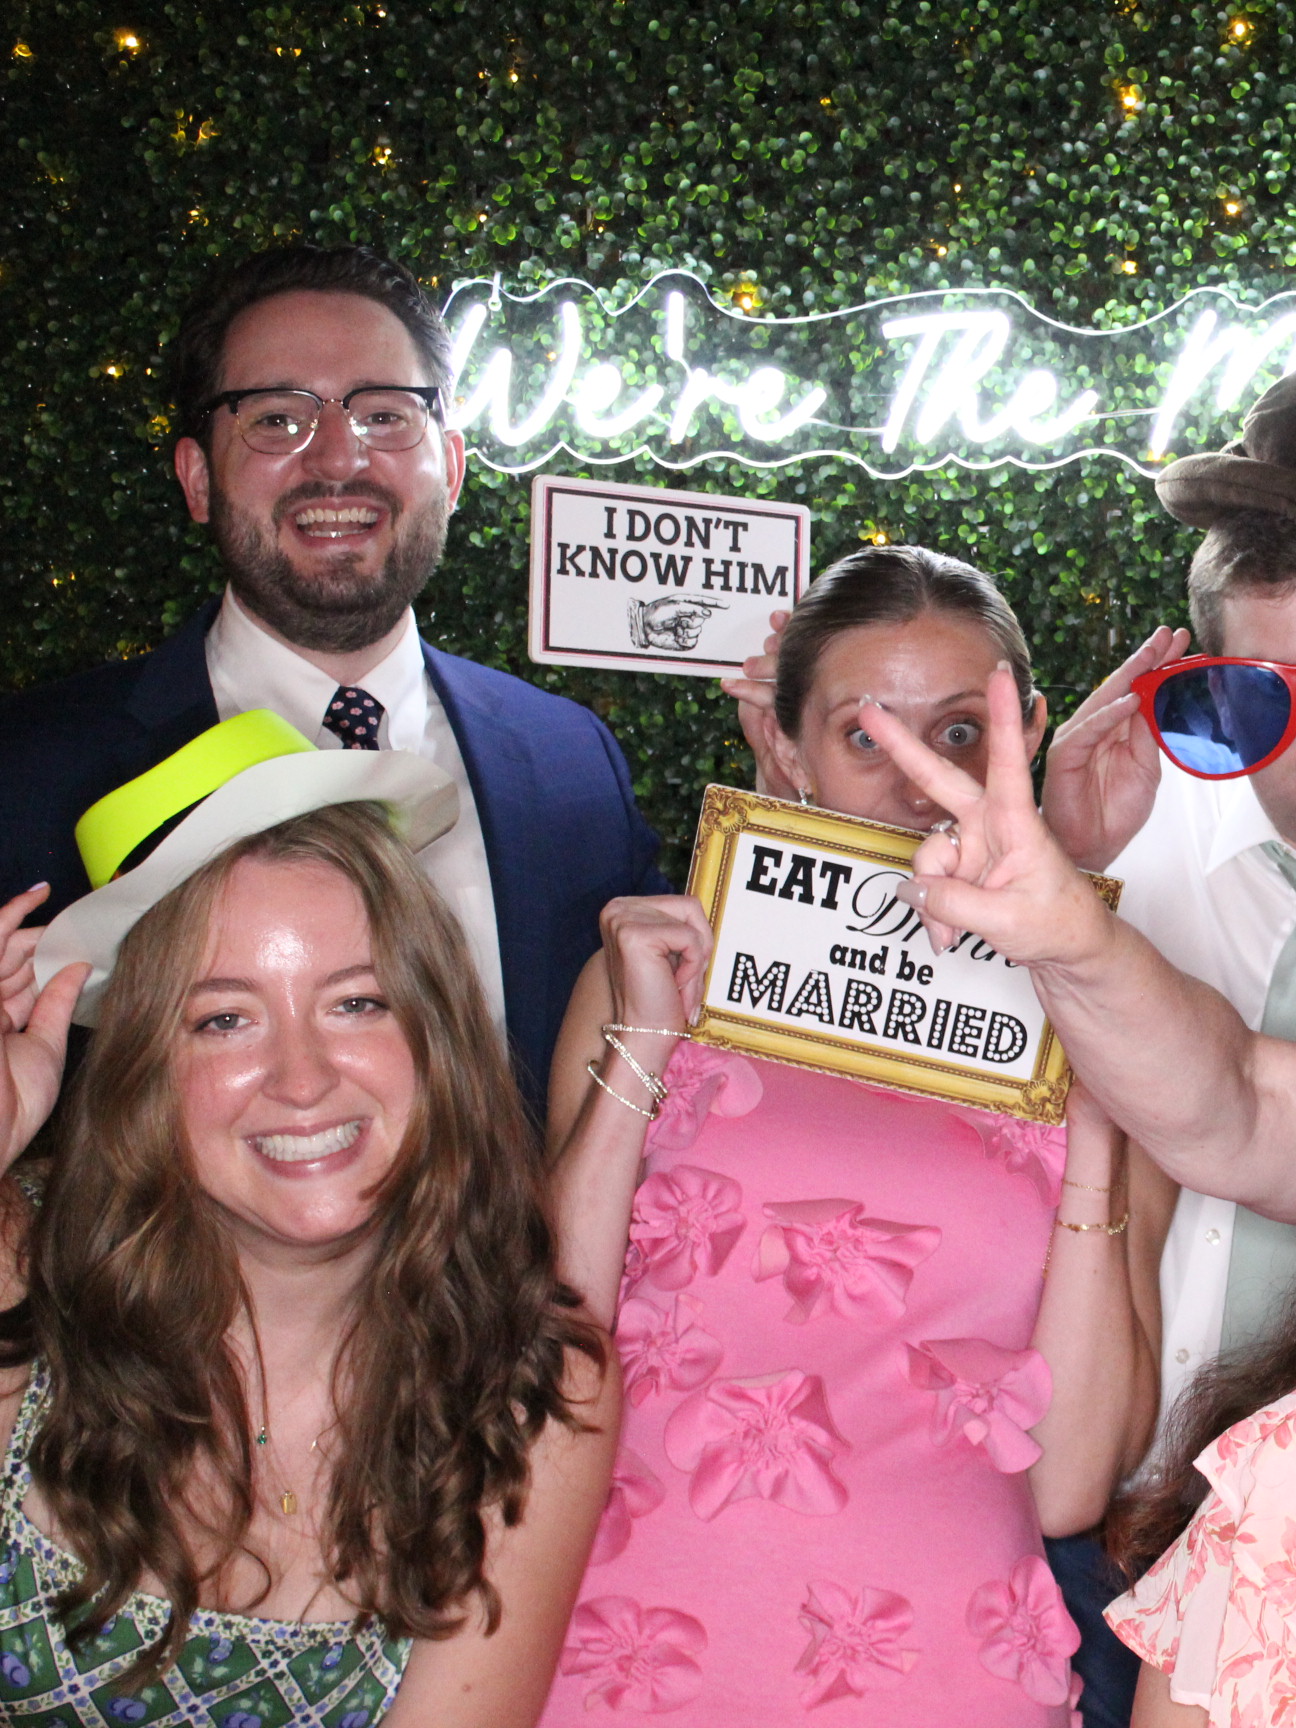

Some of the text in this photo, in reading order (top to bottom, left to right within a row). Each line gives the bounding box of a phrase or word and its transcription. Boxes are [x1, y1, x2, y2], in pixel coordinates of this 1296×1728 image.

[446, 291, 827, 447] We're
[881, 309, 1100, 454] The
[603, 506, 749, 553] I DON'T
[556, 542, 789, 597] KNOW HIM
[745, 844, 853, 911] EAT
[828, 942, 935, 987] and be
[726, 951, 1029, 1065] MARRIED
